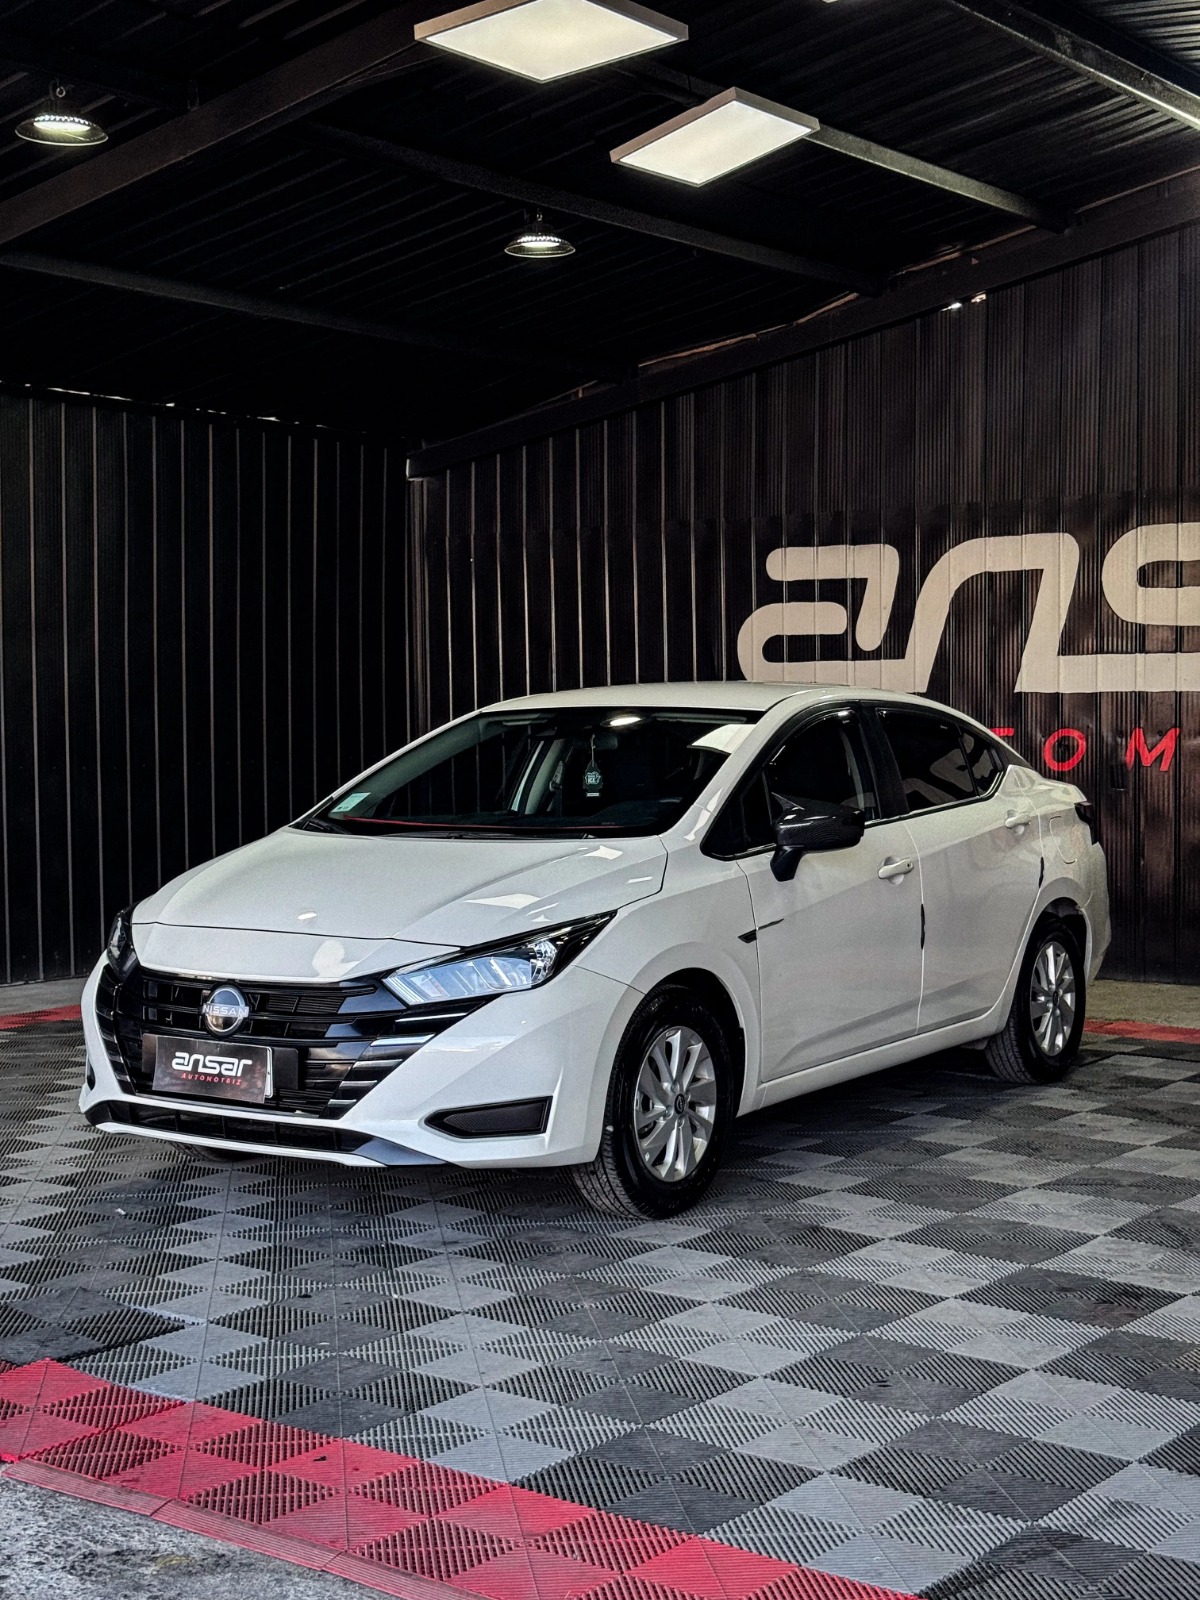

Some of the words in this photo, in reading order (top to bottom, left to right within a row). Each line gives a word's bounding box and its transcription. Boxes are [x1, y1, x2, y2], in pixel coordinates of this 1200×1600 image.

[990, 728, 1181, 771] OM
[202, 1003, 248, 1016] NISSAN
[171, 1051, 252, 1077] ansar
[181, 1072, 242, 1086] AUTOMOTRIZ
